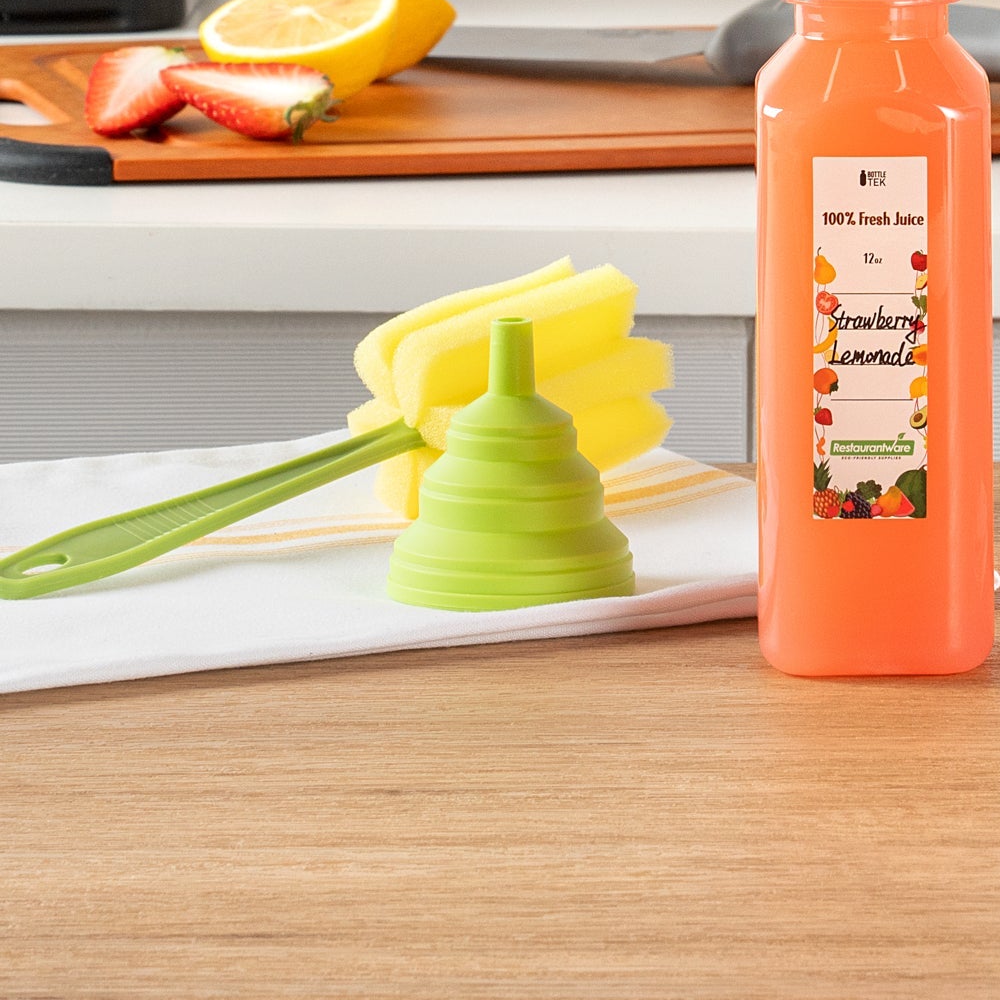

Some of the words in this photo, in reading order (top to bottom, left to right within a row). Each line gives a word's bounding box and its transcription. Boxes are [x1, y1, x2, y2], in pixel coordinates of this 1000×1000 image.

[867, 178, 887, 187] TEK
[822, 211, 856, 226] 100%
[858, 211, 890, 226] Fresh
[893, 211, 925, 226] Juice
[829, 304, 927, 344] Strawberry
[828, 340, 917, 367] Lemonade
[832, 440, 911, 453] Restaurantware
